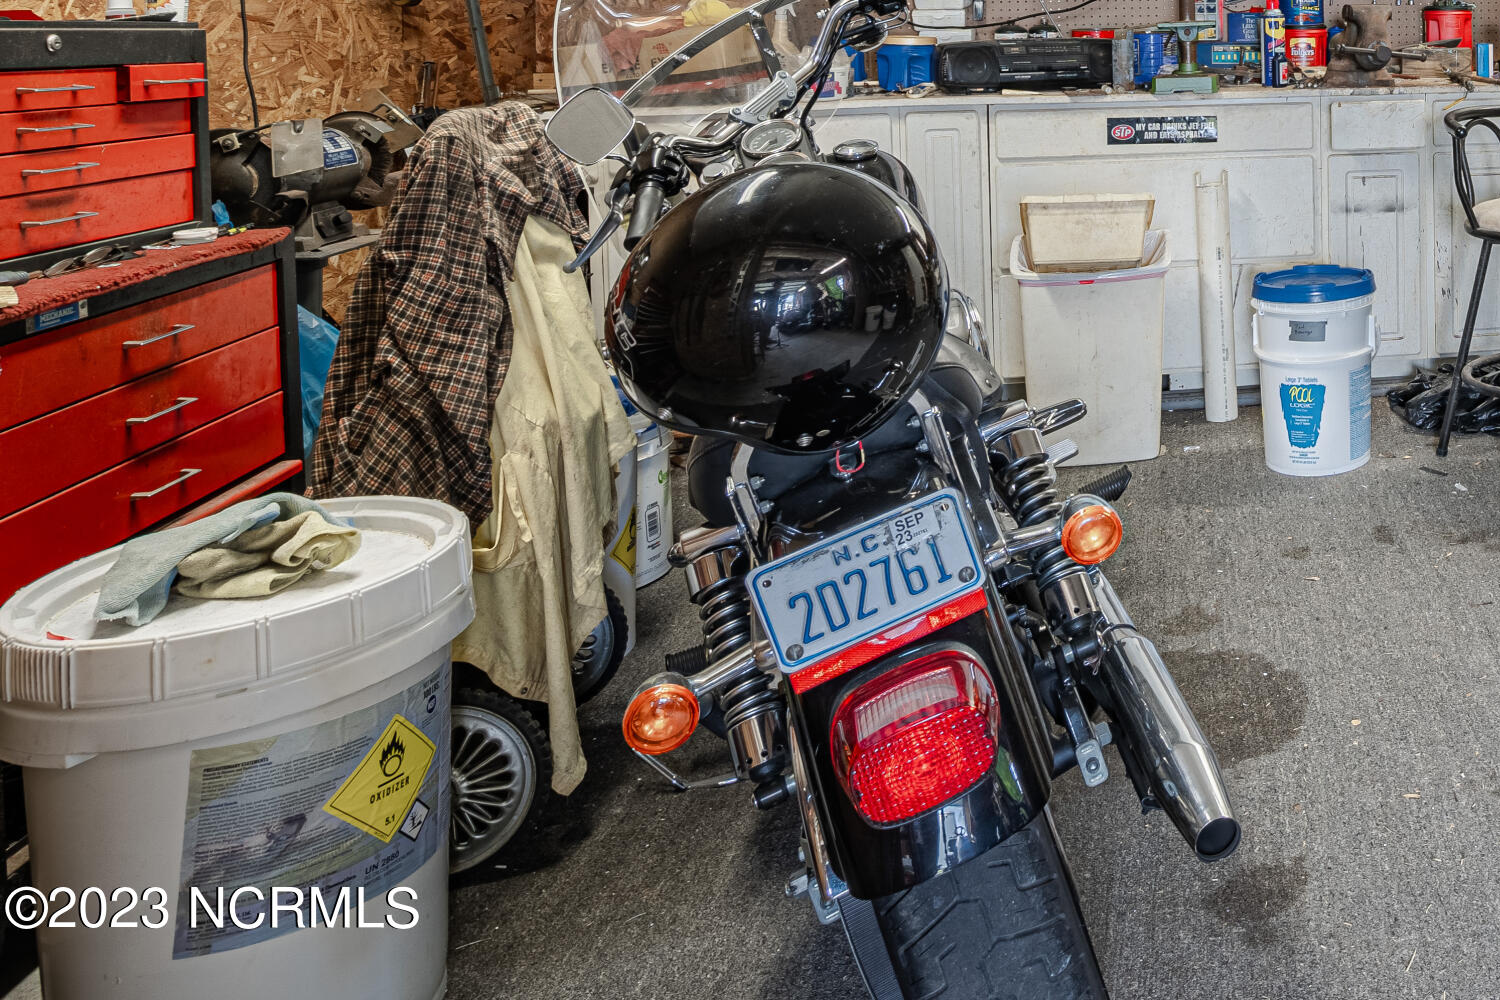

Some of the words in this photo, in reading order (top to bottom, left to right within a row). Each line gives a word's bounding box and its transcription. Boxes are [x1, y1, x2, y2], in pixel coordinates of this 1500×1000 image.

[1291, 46, 1314, 57] Folgers
[1115, 127, 1131, 137] STP
[1135, 123, 1146, 131] MY
[1148, 122, 1160, 131] CAR
[1188, 122, 1199, 130] JET
[1144, 131, 1158, 140] AND
[1289, 385, 1315, 403] POOL
[894, 511, 924, 532] SEP
[896, 529, 913, 546] 23
[788, 534, 953, 645] 202761
[369, 775, 410, 804] OXIDIZER
[385, 814, 396, 826] 5.1
[366, 861, 379, 875] UN
